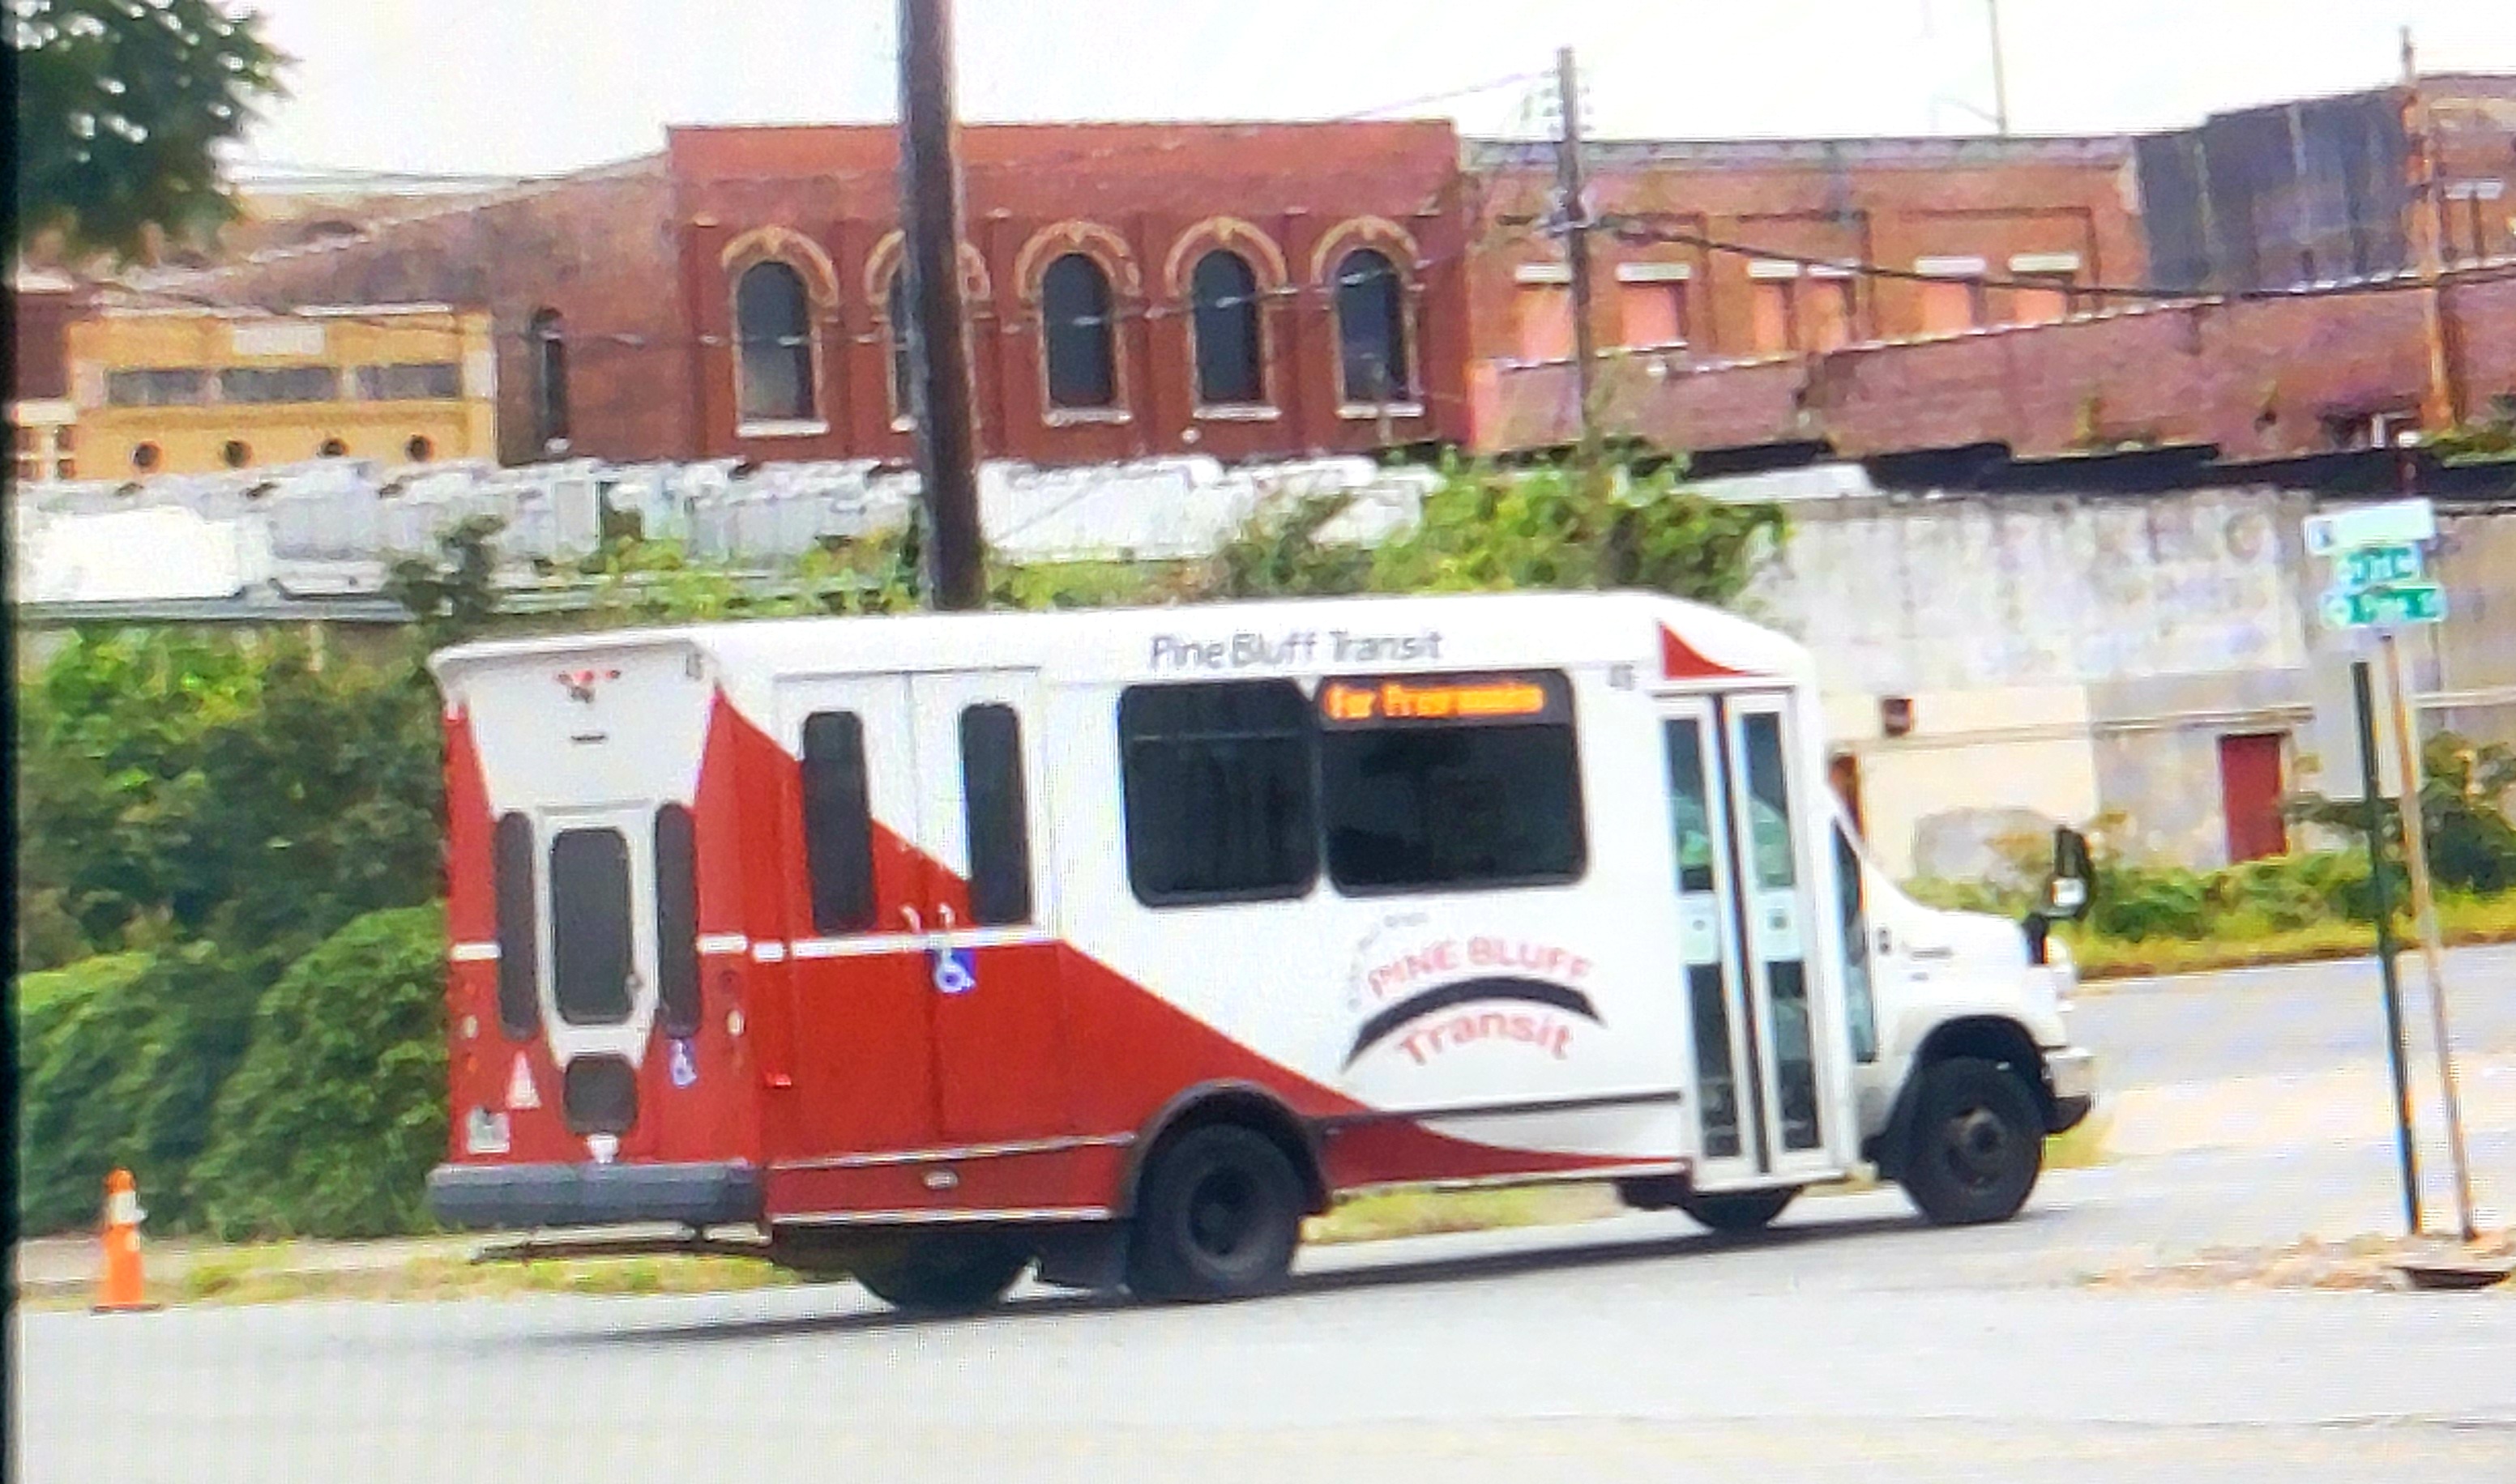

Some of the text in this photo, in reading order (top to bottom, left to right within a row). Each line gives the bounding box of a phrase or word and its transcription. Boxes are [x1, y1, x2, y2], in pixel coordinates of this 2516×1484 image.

[1151, 629, 1443, 667] Pine Bluff Transit
[1367, 937, 1460, 997] PINE
[1467, 935, 1594, 977] BLUFF
[1396, 1013, 1570, 1065] Transit
